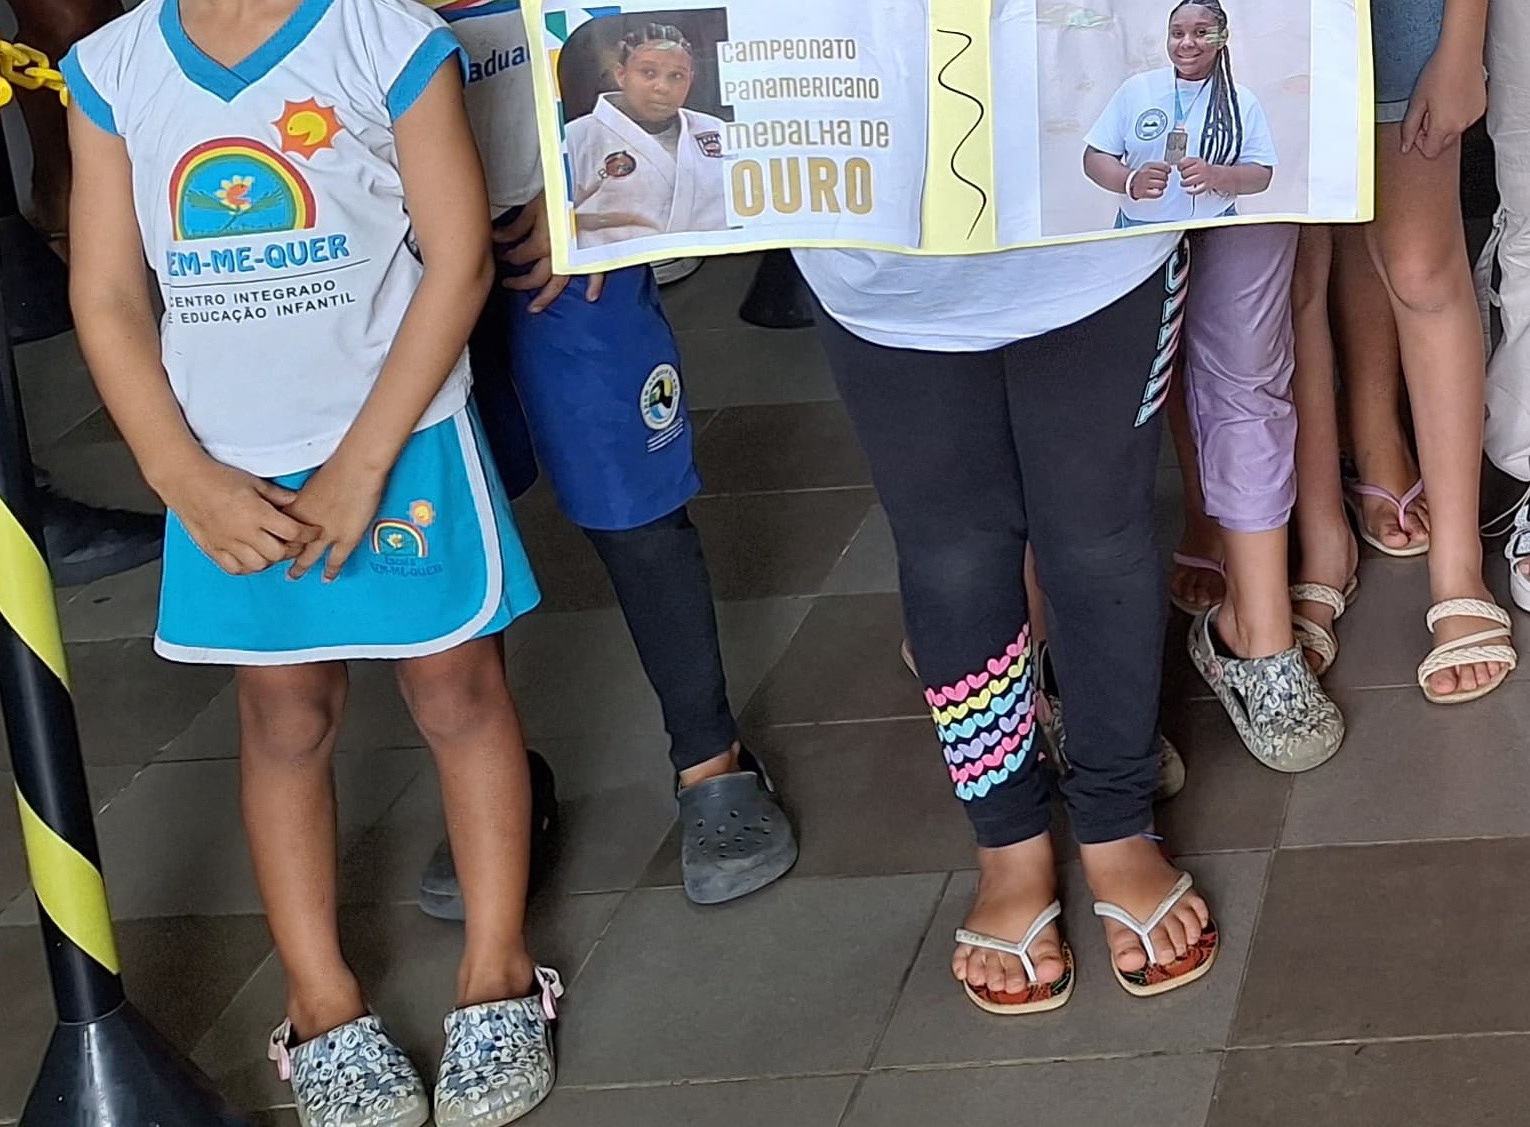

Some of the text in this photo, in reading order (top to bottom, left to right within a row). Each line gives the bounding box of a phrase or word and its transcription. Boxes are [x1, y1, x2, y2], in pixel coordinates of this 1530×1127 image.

[731, 156, 873, 217] OURO
[181, 306, 267, 324] EDUCAÇÃO
[276, 291, 356, 317] INFANTIL
[233, 280, 336, 304] INTEGRADO
